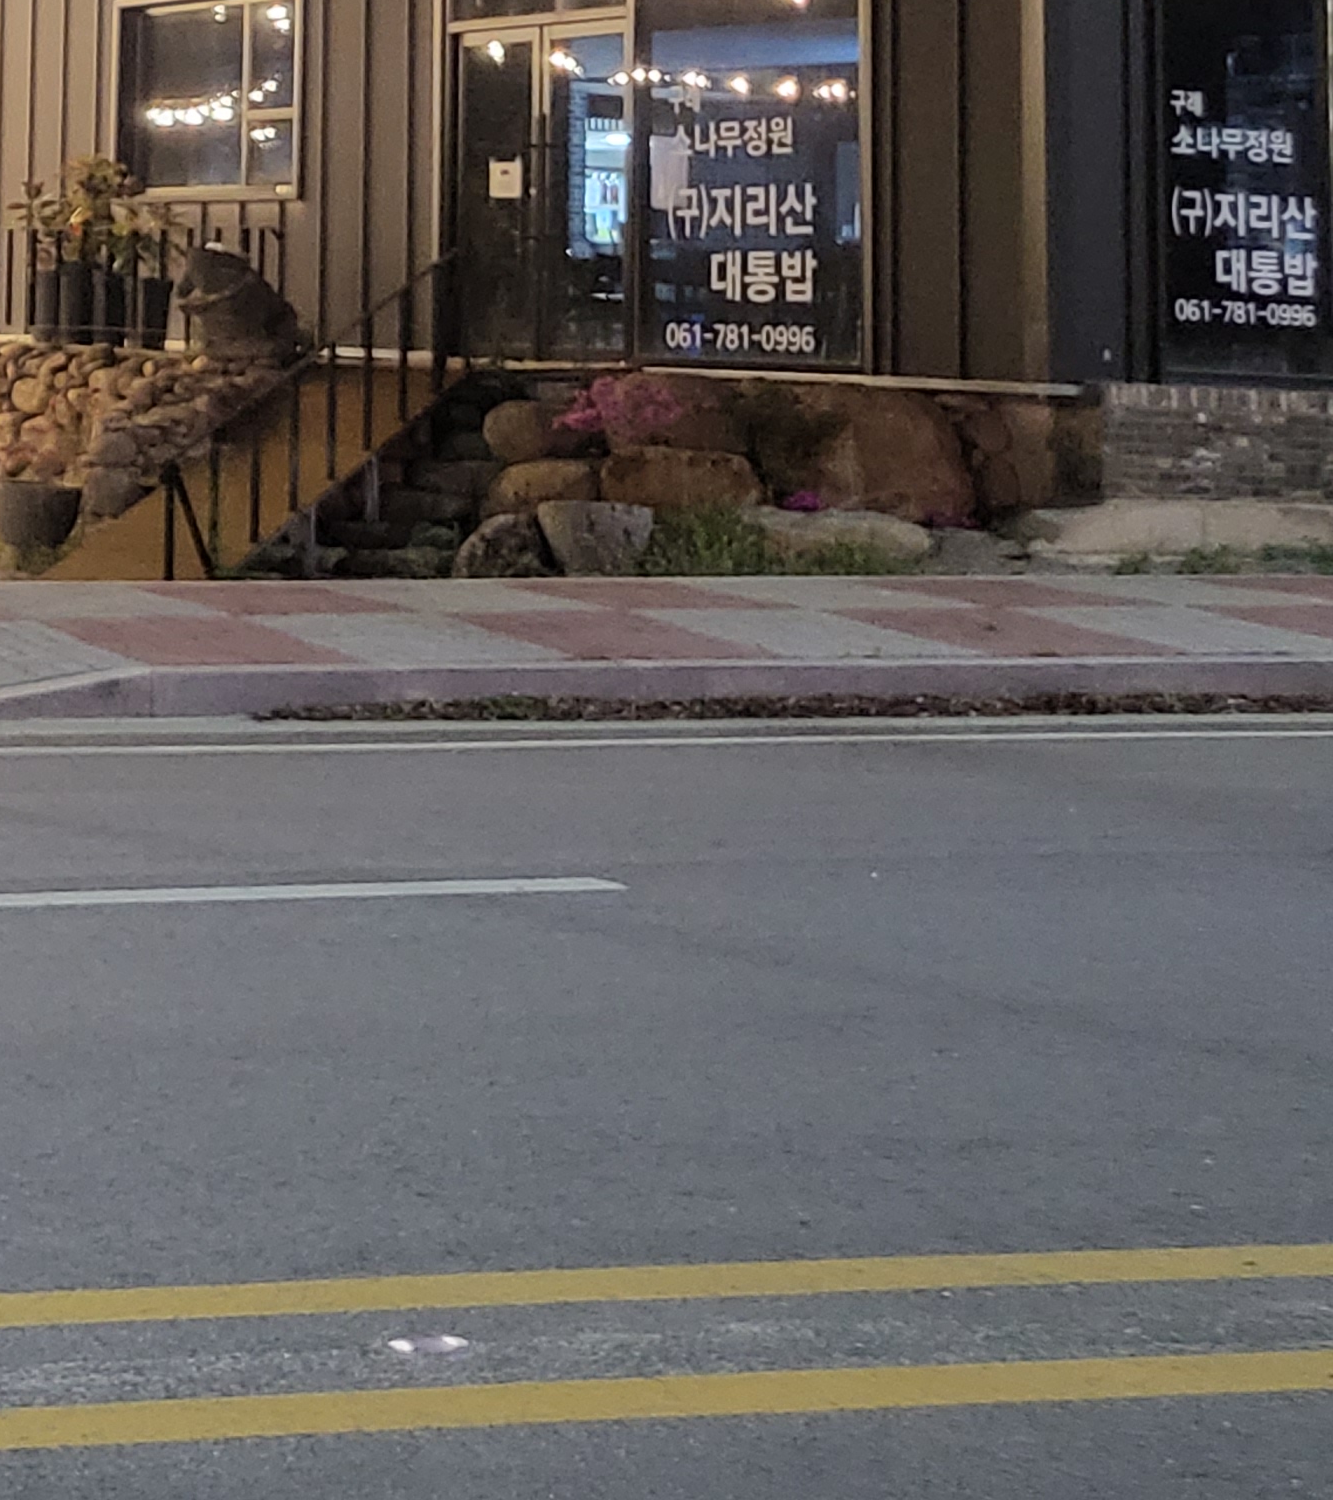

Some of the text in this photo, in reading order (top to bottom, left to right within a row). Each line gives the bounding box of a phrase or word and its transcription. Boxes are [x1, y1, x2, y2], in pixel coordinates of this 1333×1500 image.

[672, 116, 794, 158] 소나무정원
[1170, 124, 1294, 164] 소나무정원
[668, 183, 818, 240] (구)지리산
[1171, 186, 1318, 239] (구)지리산
[710, 249, 818, 304] 대통밥
[1214, 248, 1319, 297] 대통밥
[1174, 298, 1317, 327] 061-781-0996
[665, 322, 816, 354] 061-781-0996
